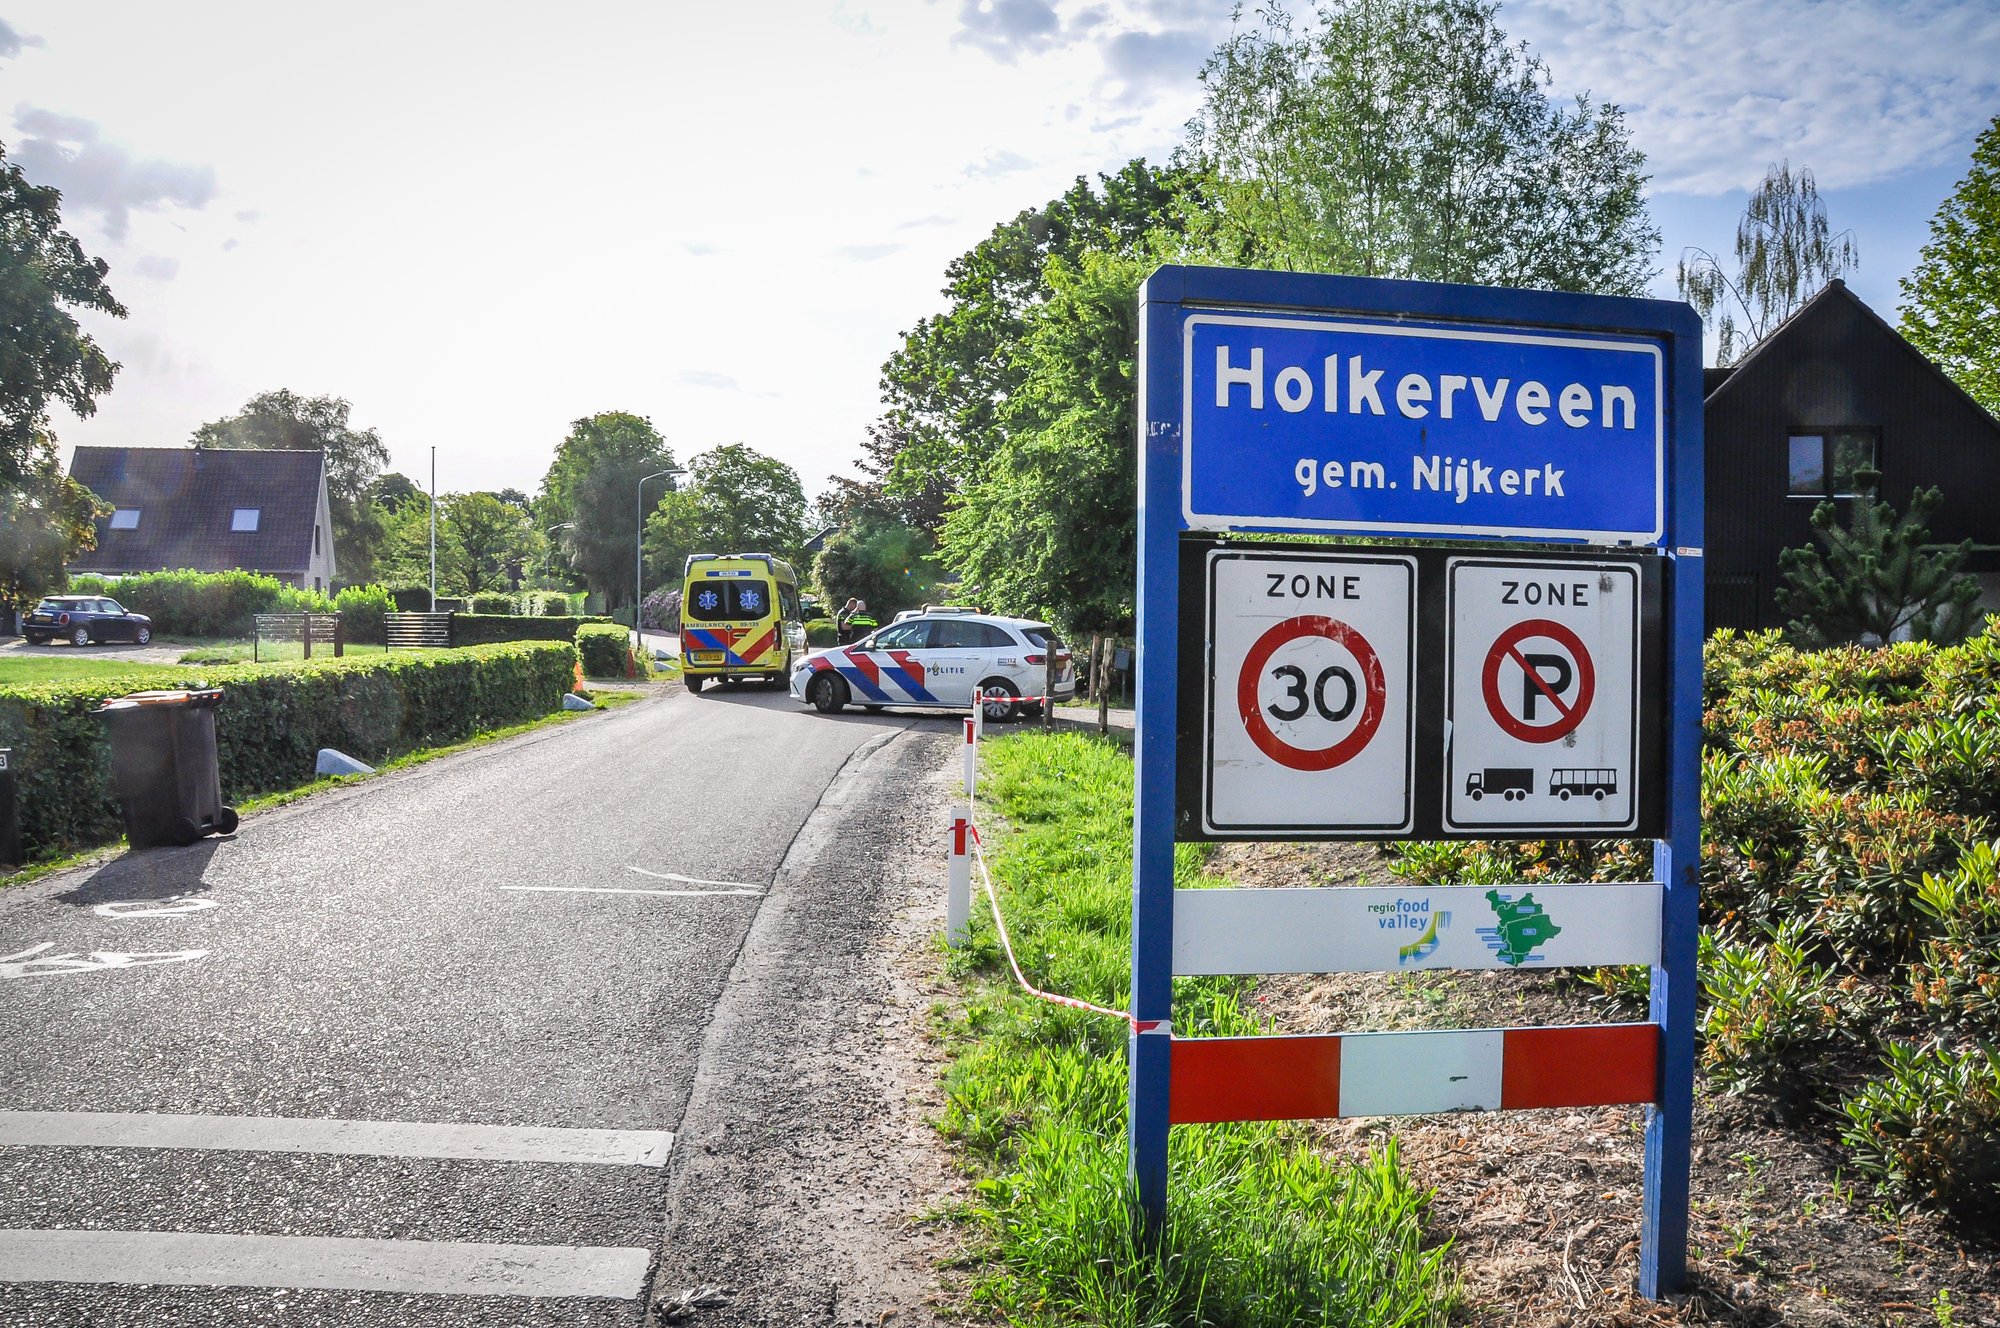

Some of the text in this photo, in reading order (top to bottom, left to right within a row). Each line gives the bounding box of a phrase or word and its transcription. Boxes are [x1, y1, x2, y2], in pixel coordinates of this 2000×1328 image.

[1215, 345, 1636, 429] Holkerveen
[1295, 455, 1565, 503] gem. Nijkerk
[1266, 573, 1361, 600] ZONE
[1501, 581, 1589, 606] ZONE
[926, 665, 965, 675] POLITIE
[1267, 665, 1357, 722] 30
[1378, 914, 1428, 931] valley
